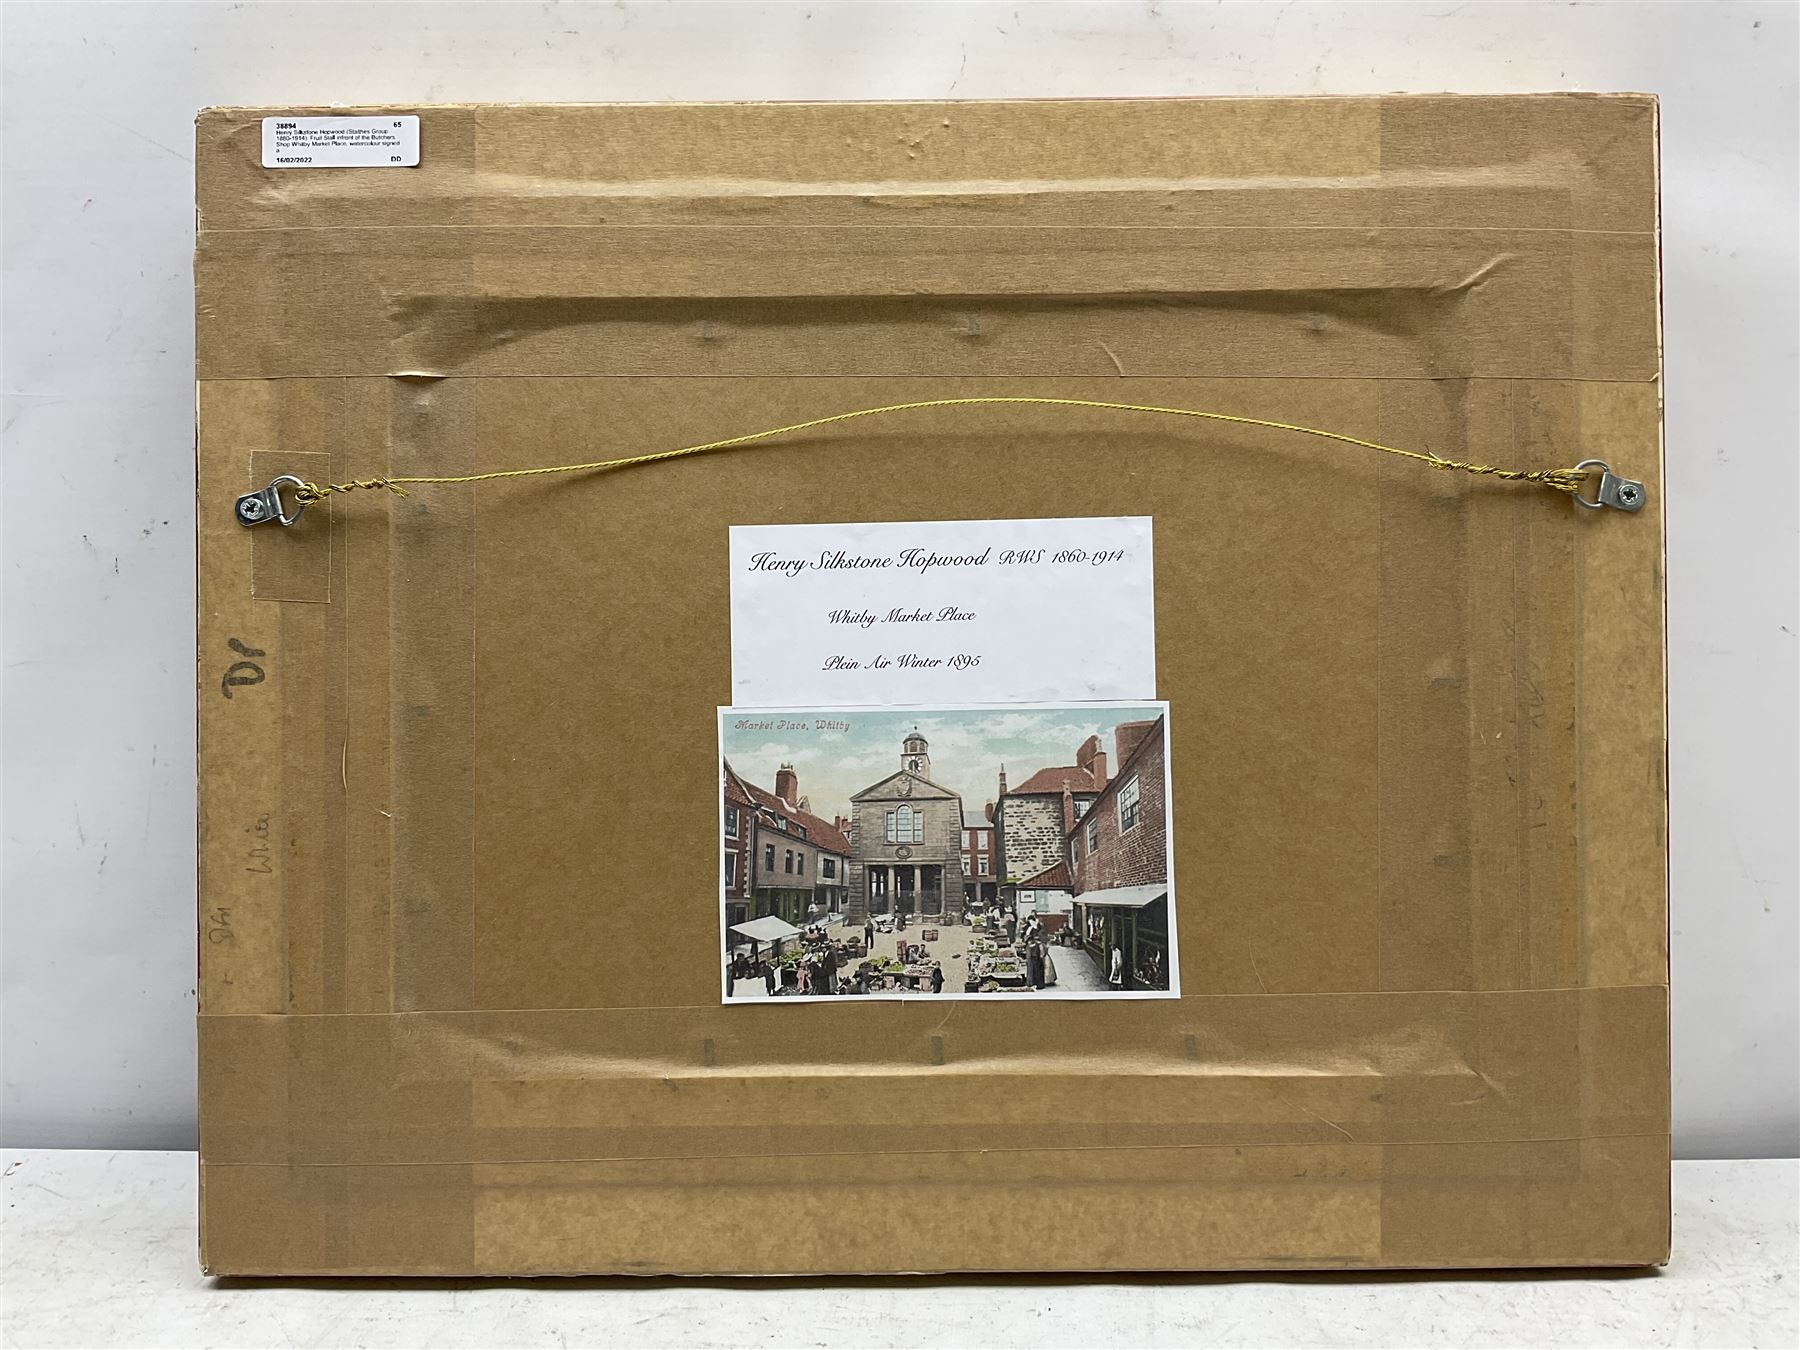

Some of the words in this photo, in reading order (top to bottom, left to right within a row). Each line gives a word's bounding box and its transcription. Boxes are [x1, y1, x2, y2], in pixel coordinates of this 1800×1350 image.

[276, 122, 297, 130] 38894
[748, 551, 808, 578] Henry
[809, 550, 893, 571] Silkstone
[896, 546, 992, 575] Hopwood
[998, 549, 1046, 565] RWS
[1051, 548, 1125, 567] 1860-1914
[827, 608, 878, 629] Whitby
[880, 607, 934, 624] Market
[935, 606, 977, 623] Place
[821, 655, 861, 671] Plein
[863, 654, 893, 670] Air
[896, 653, 943, 669] Winter
[946, 653, 982, 671] 1895
[734, 719, 774, 730] Market
[776, 719, 809, 731] Place,
[815, 719, 851, 733] Whitby
